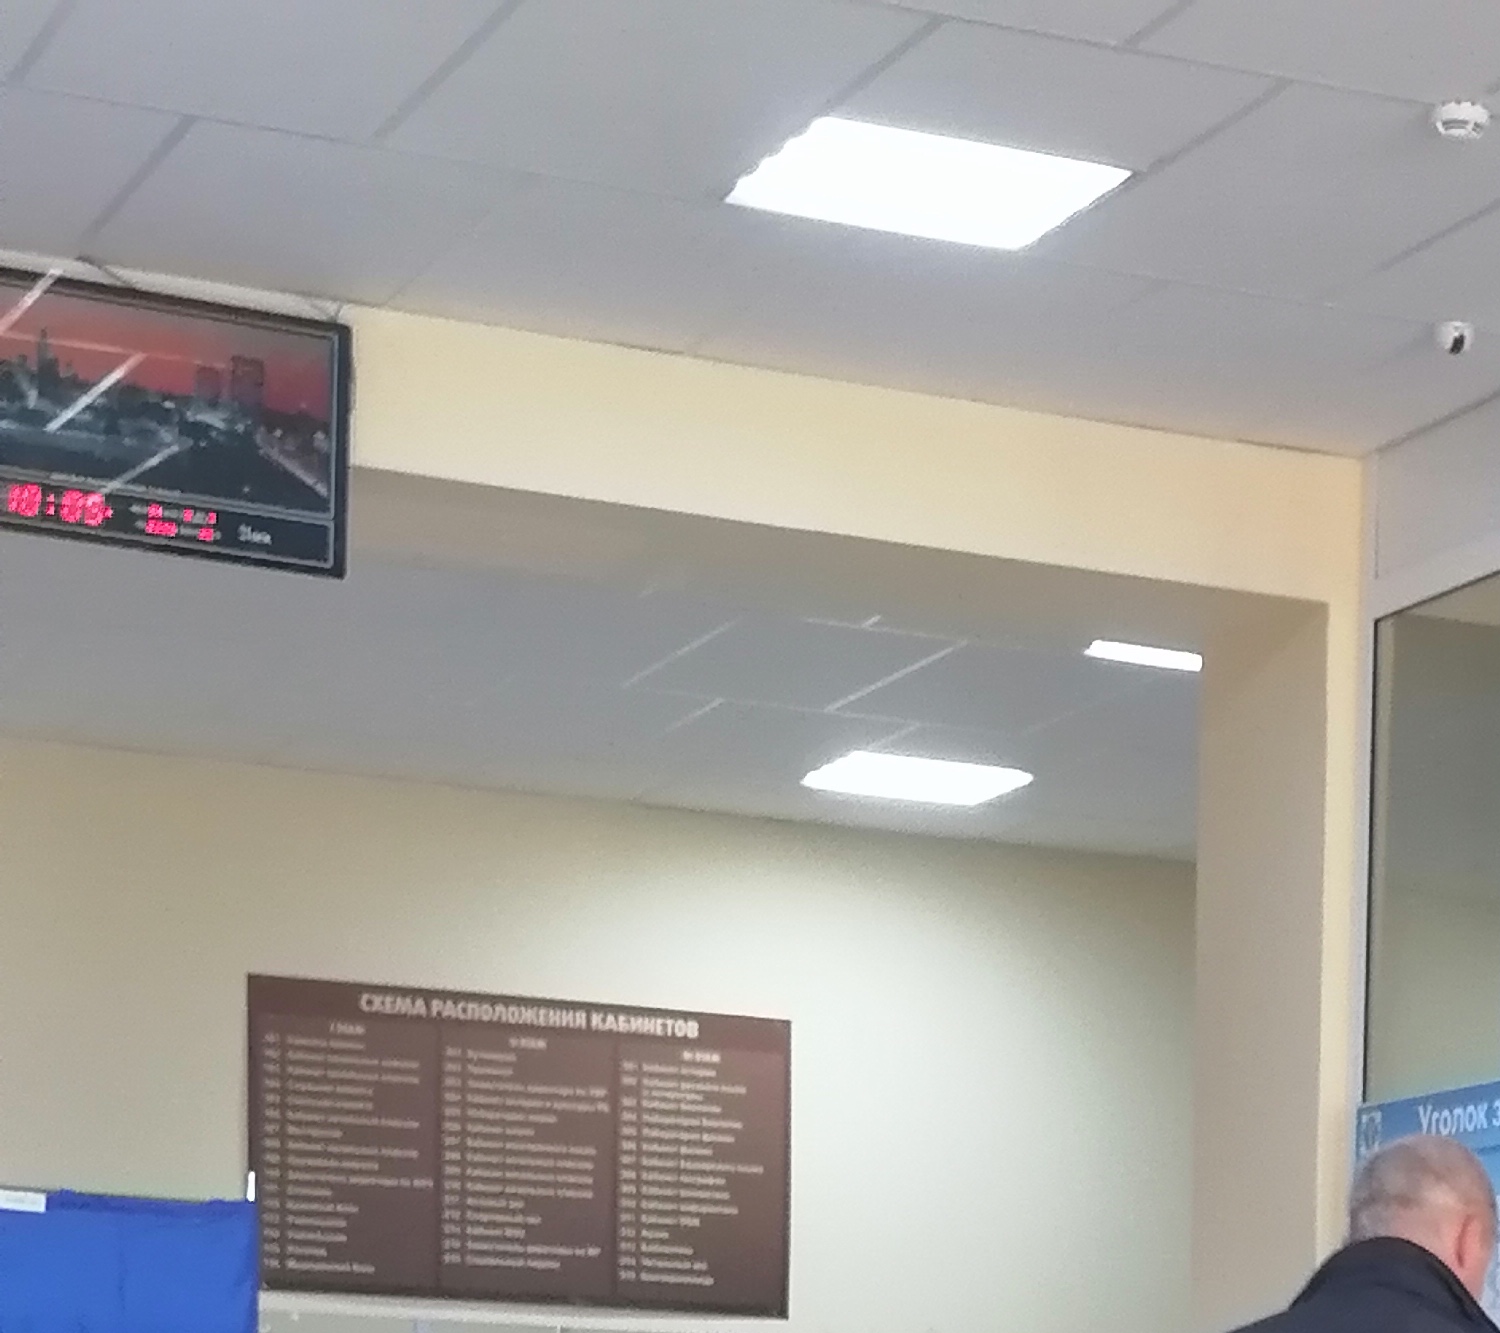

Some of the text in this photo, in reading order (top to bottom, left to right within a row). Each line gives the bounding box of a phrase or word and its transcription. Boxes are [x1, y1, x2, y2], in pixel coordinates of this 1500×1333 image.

[359, 993, 700, 1039] СХЕМА РАСПОЛОЖЕНИЯ КАБИНЕТОВ
[1418, 1101, 1489, 1137] Уголок
